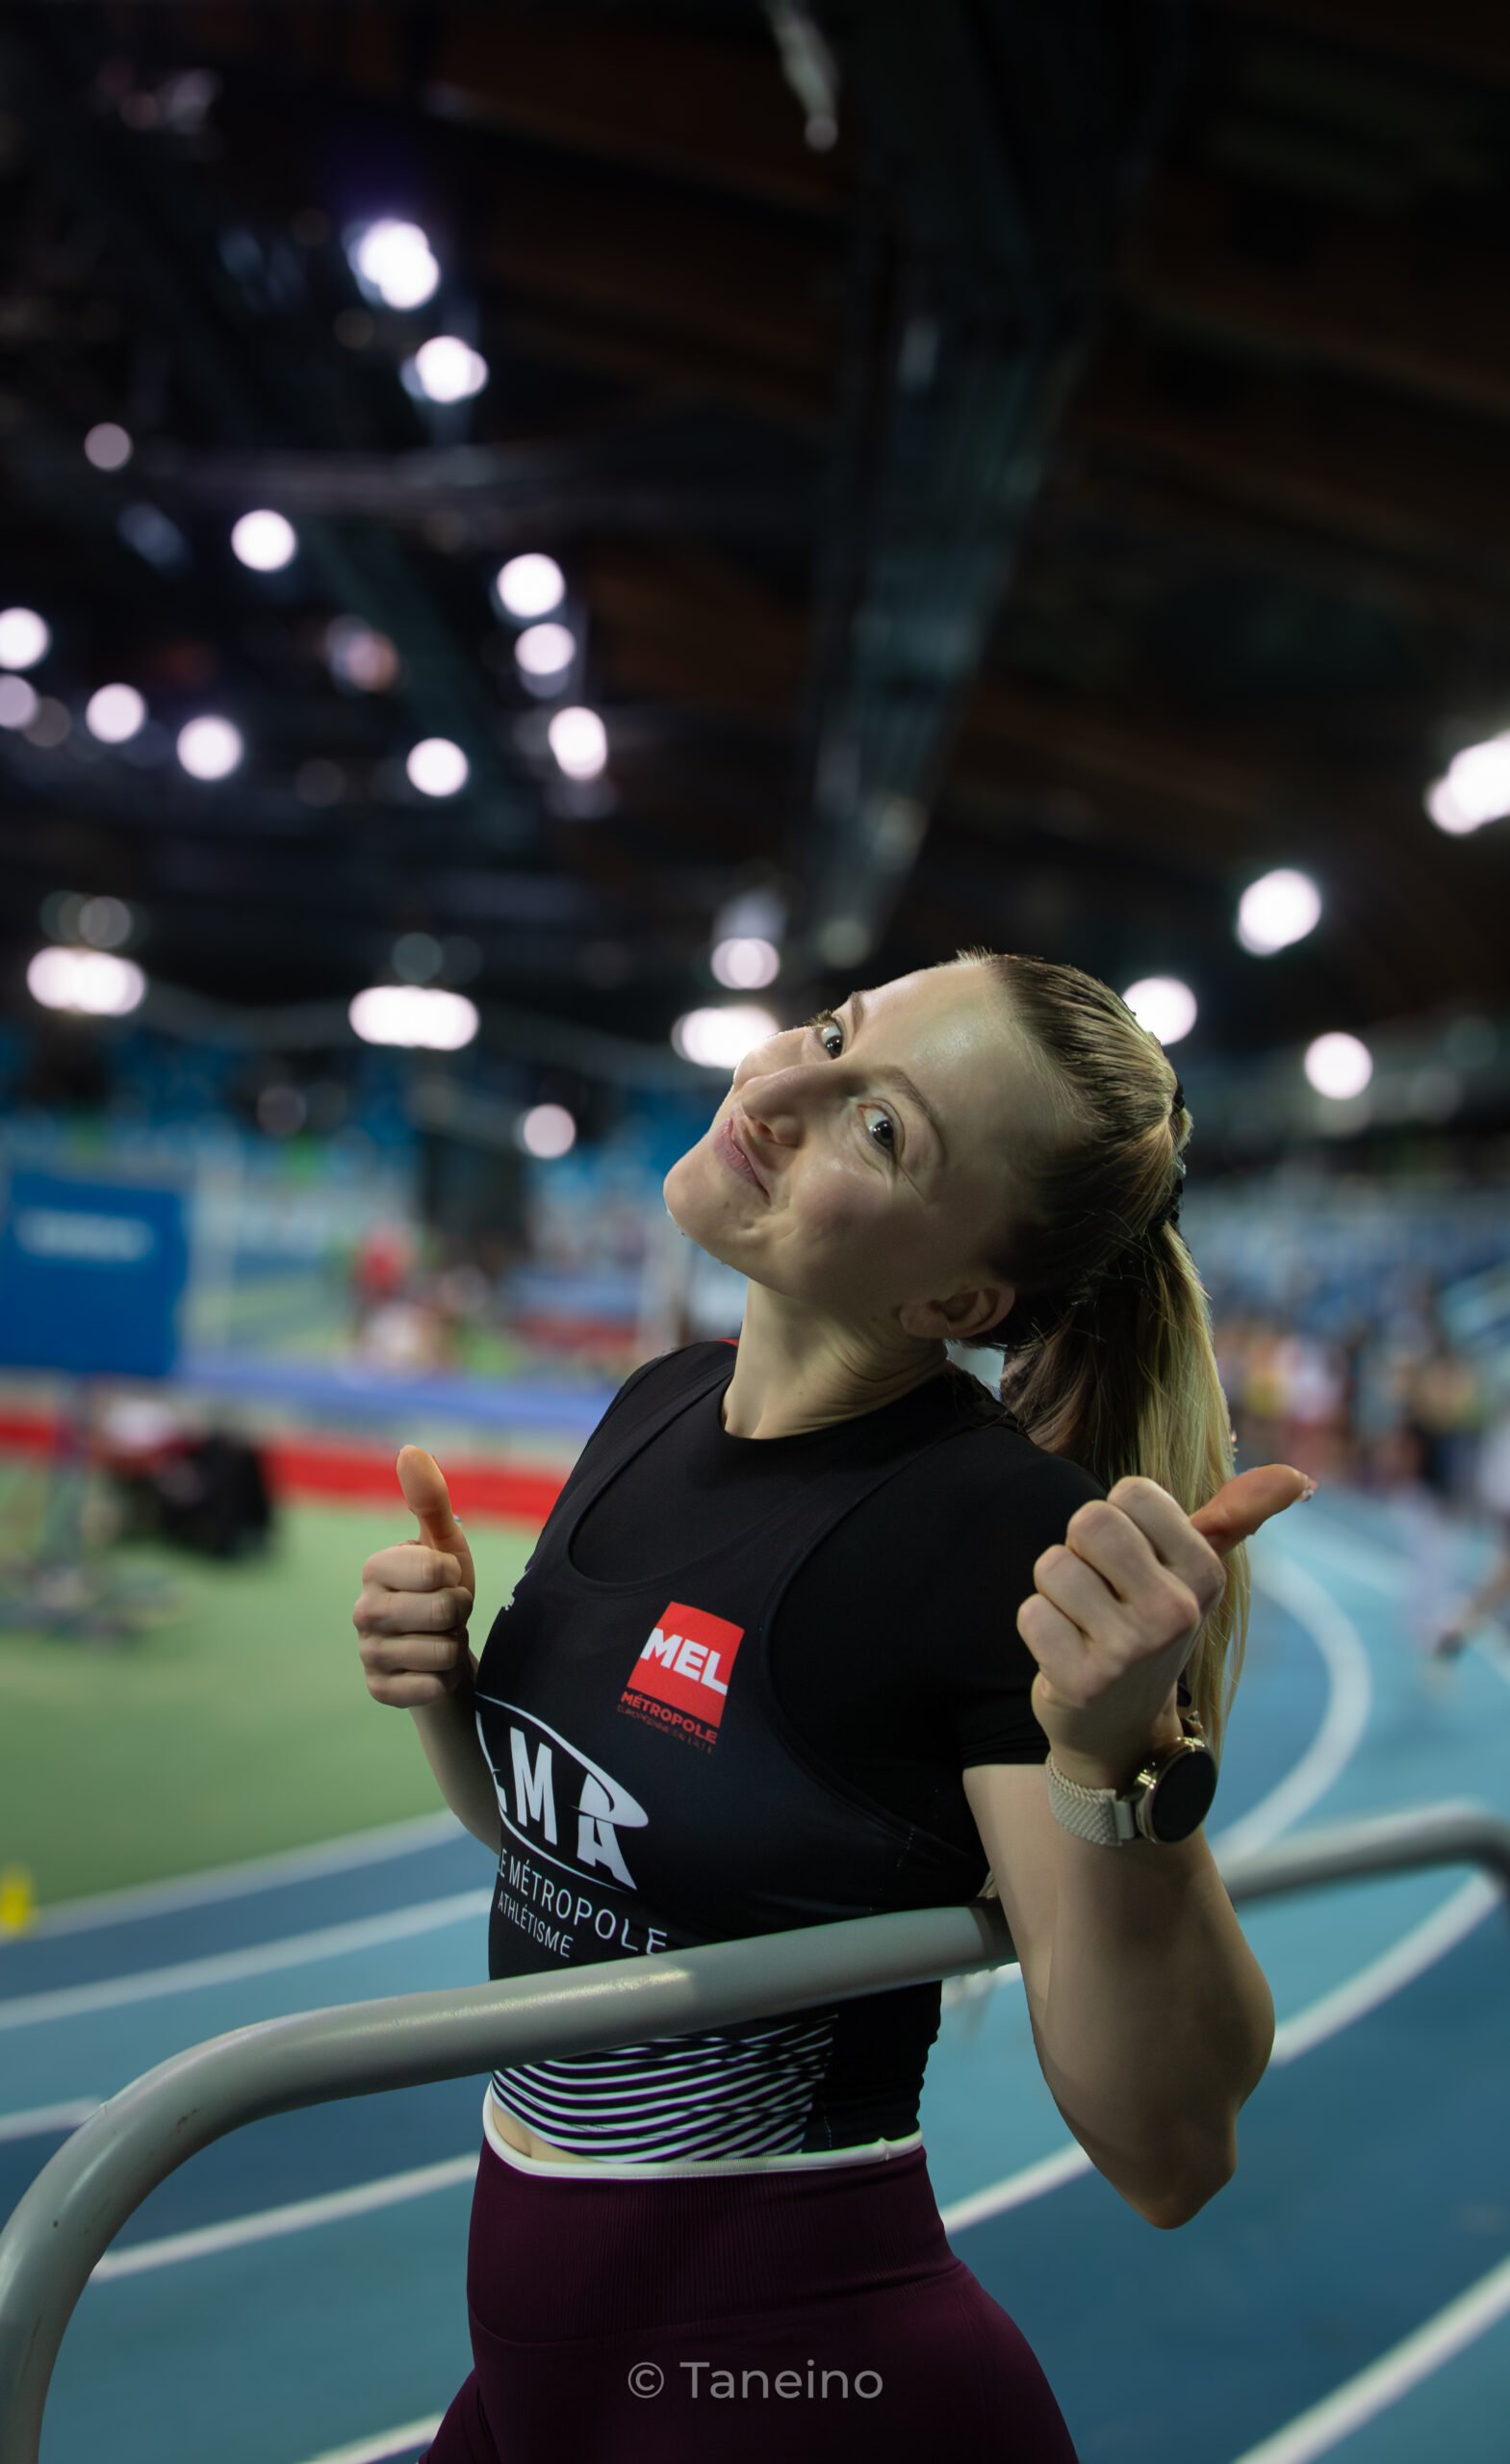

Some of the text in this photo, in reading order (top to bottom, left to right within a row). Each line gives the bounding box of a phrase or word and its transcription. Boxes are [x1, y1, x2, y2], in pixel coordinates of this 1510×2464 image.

[640, 1627, 729, 1696] MEL
[620, 1691, 718, 1745] MÉTROPOLE
[498, 1890, 574, 1959] ATHLÉTISME
[508, 1856, 668, 1956] MÉTROPOLE
